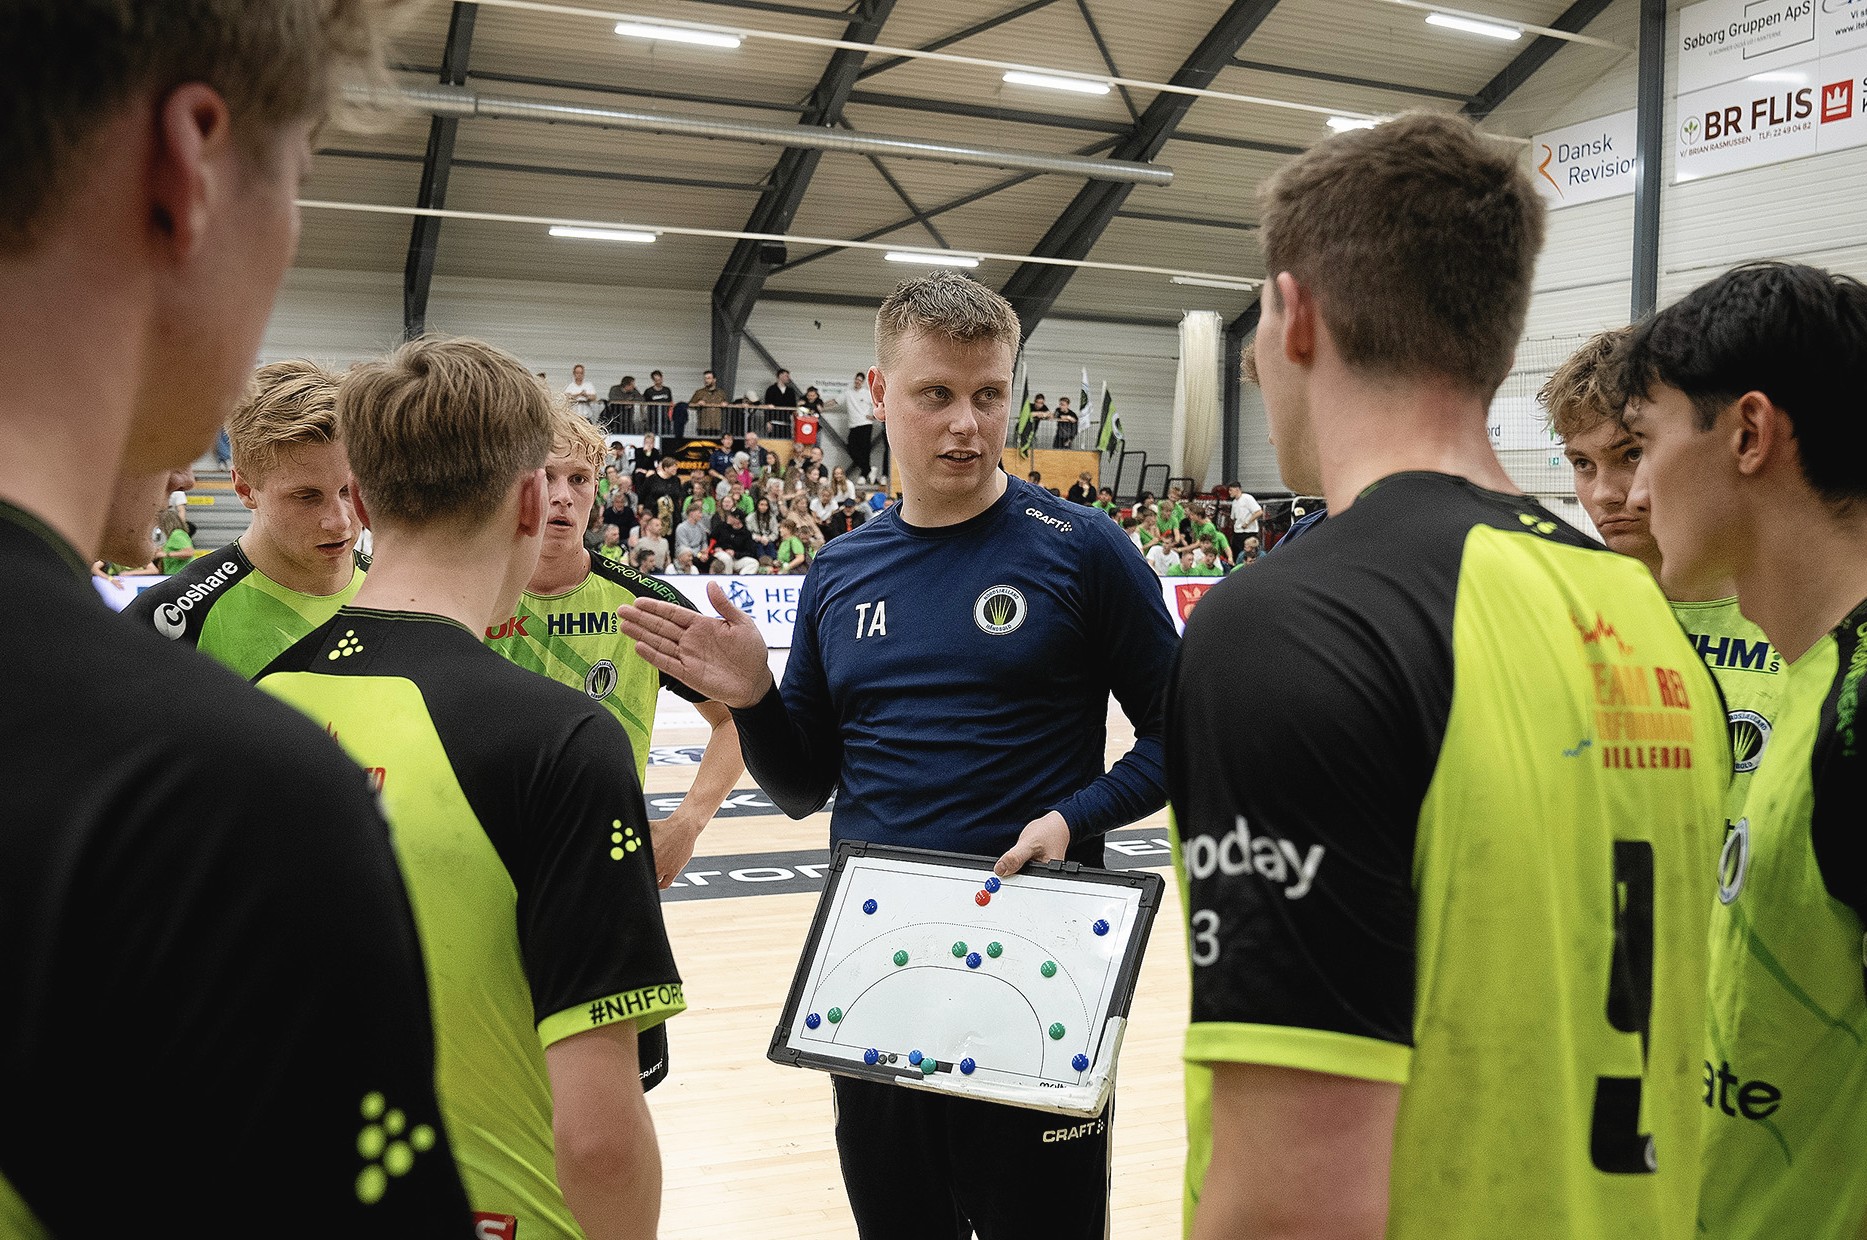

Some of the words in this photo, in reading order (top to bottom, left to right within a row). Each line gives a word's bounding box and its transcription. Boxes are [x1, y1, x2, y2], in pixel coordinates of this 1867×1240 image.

[1683, 30, 1725, 51] Søborg
[1728, 12, 1781, 37] Gruppen
[1784, 0, 1810, 20] ApS
[1704, 106, 1742, 141] BR
[1751, 88, 1812, 130] FLIS
[1558, 133, 1612, 163] Dansk
[1688, 145, 1709, 156] BRIAN
[1709, 136, 1751, 151] RASMUSSEN
[1025, 507, 1064, 528] CRAFT
[547, 611, 609, 635] HHM
[856, 600, 887, 639] TA
[1043, 1121, 1096, 1143] CRAFT
